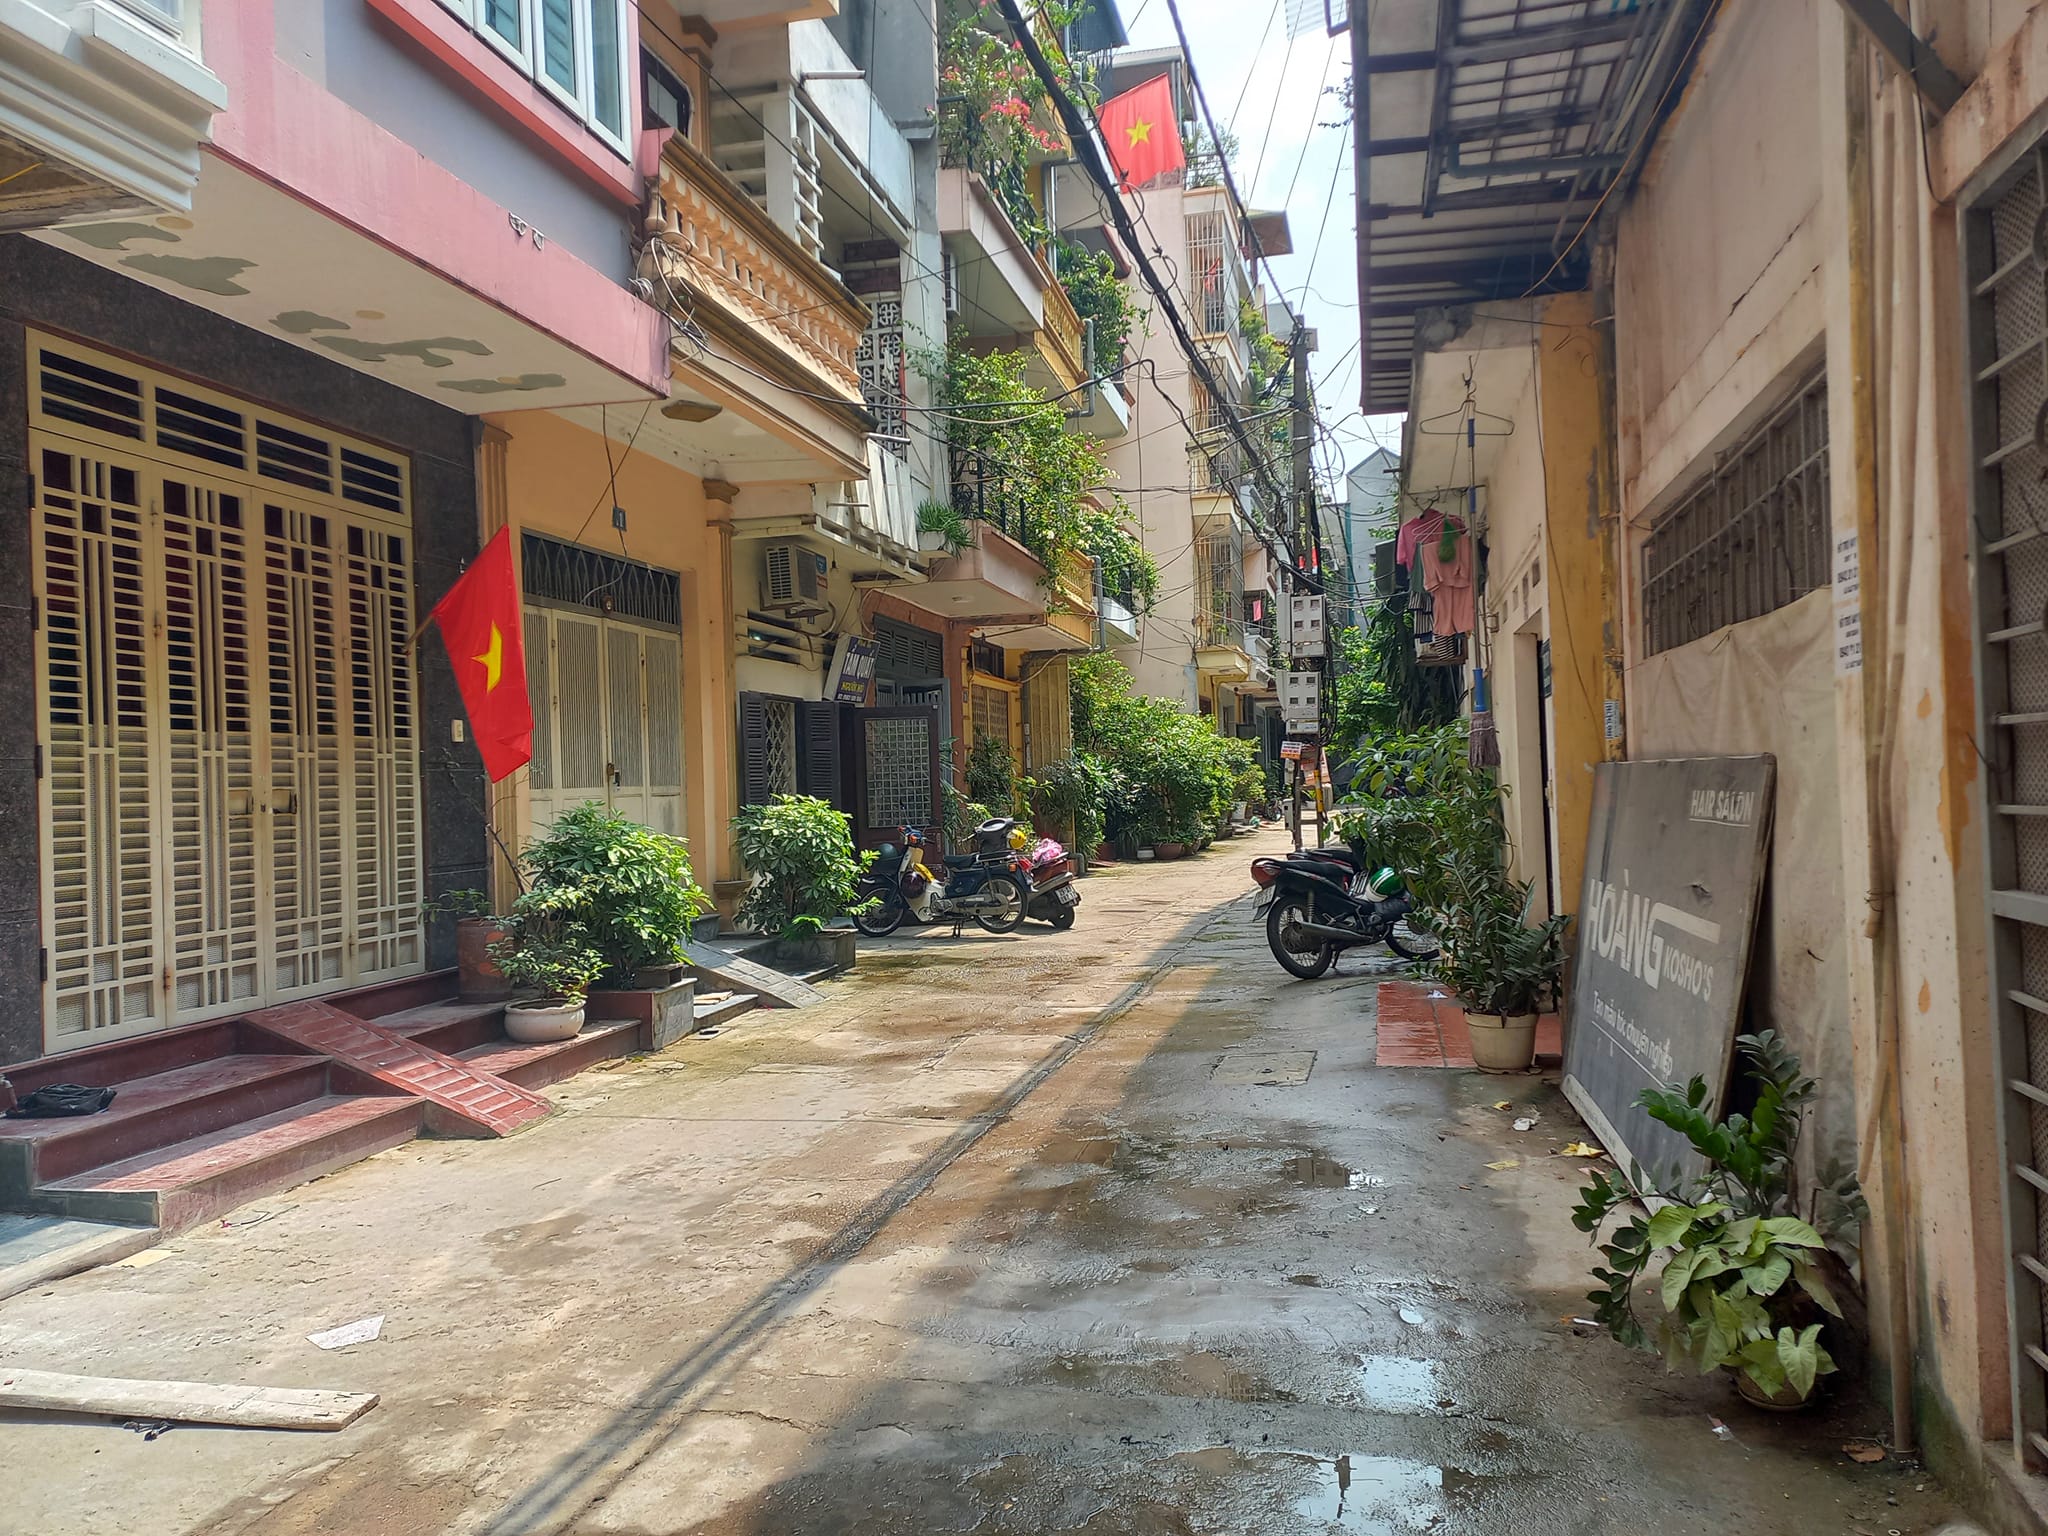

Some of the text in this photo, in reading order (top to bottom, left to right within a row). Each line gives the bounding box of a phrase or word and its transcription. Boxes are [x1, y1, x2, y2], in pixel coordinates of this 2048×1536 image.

[1690, 790, 1755, 823] HAIR SALON
[1583, 868, 1720, 990] HOÀNG
[1663, 945, 1714, 1002] KOSHO'S
